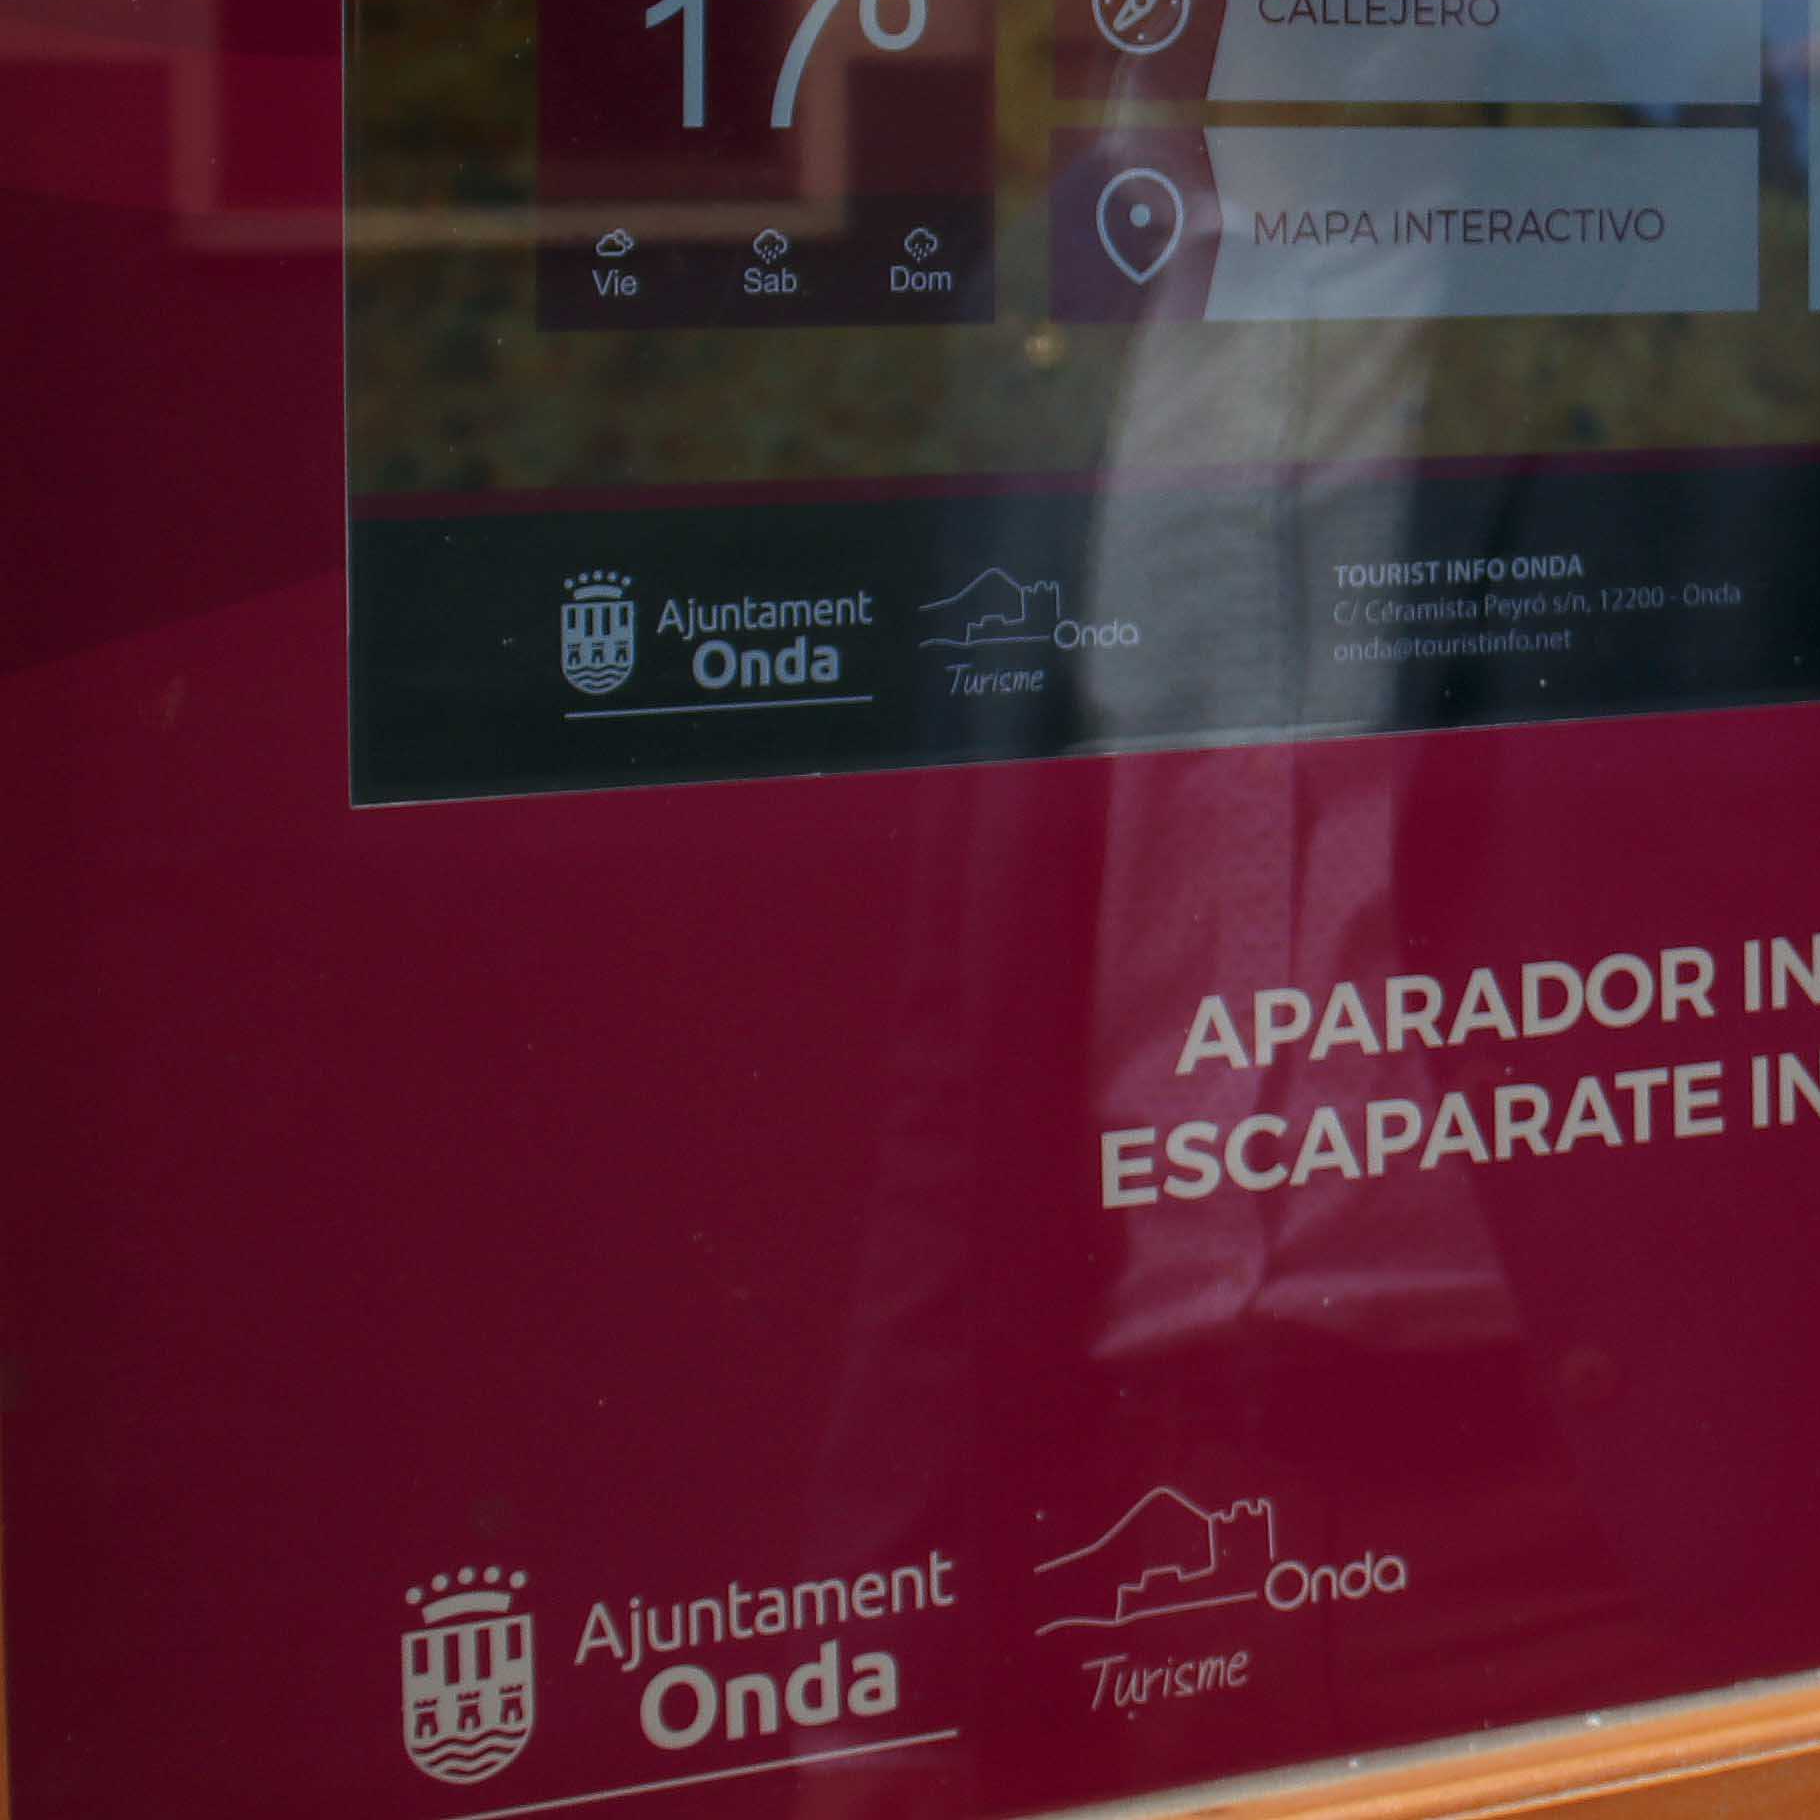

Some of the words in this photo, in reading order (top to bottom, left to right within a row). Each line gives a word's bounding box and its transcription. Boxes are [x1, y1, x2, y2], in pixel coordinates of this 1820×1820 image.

[1252, 210, 1379, 246] MAPA
[1391, 207, 1666, 244] INTERACTIVO
[592, 268, 638, 297] Vie
[743, 266, 798, 296] Sab
[889, 264, 952, 293] Dom
[1333, 560, 1440, 589] TOURIST
[1447, 557, 1505, 585] INFO
[1511, 553, 1585, 581] ONDA
[656, 590, 873, 641] Ajuntament
[1600, 585, 1665, 613] 12200
[1682, 580, 1742, 607] Onda
[1053, 620, 1140, 650] Onda
[1333, 627, 1574, 662] onda@touristinfo.net
[691, 636, 841, 690] Onda
[945, 661, 1046, 696] Turisme
[1176, 945, 1715, 1076] APARADOR
[1101, 1061, 1725, 1209] ESCAPARATE
[1263, 1551, 1406, 1613] Onda
[573, 1551, 955, 1674] Ajuntament
[640, 1639, 898, 1751] Onda
[1081, 1649, 1250, 1714] Turisme
